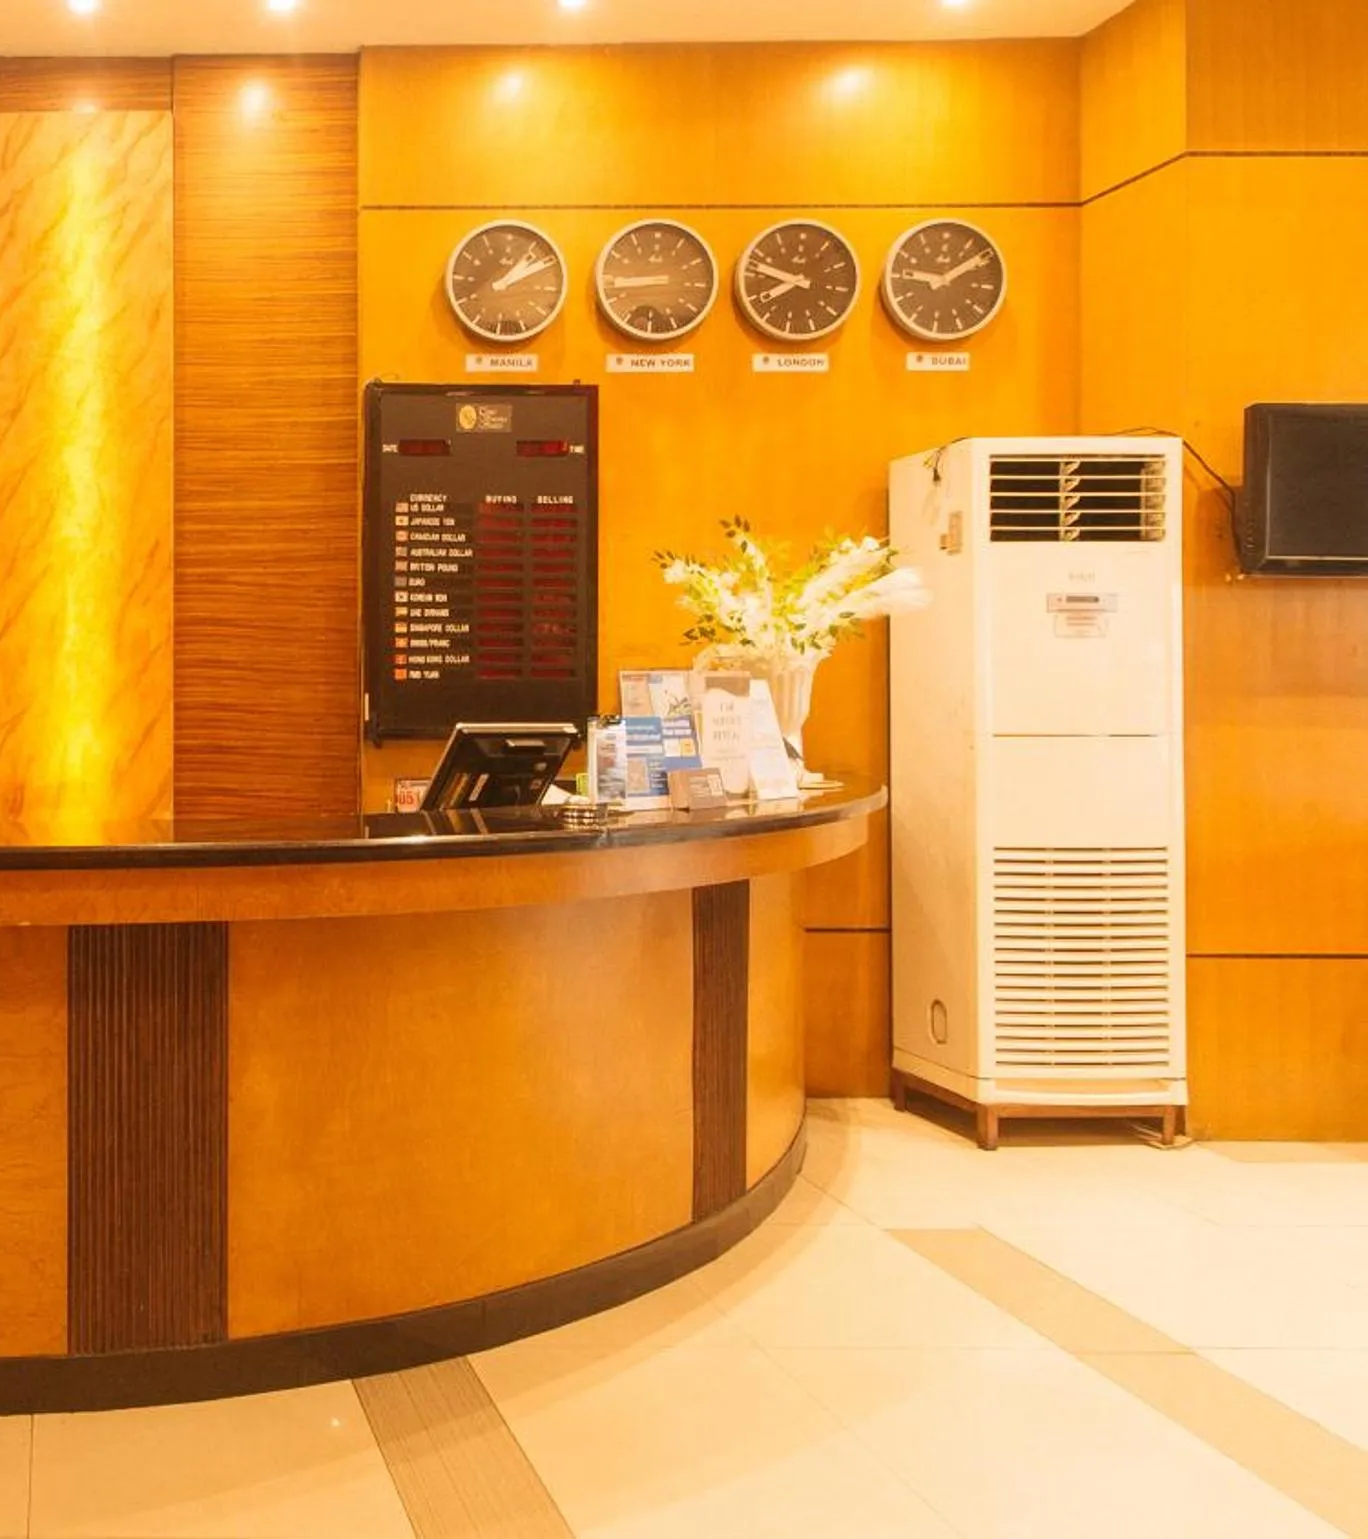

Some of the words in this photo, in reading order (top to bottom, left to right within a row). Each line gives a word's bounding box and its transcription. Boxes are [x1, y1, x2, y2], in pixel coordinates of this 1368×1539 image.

[490, 358, 532, 367] MANILA
[631, 358, 656, 368] NEW
[660, 358, 690, 367] YORK
[777, 358, 825, 367] LONDON
[931, 356, 967, 366] DUBAI
[410, 493, 447, 502] CURRENCY
[485, 495, 517, 504] BUYING
[537, 495, 574, 504] SELLING
[421, 502, 444, 512] DOLLAR
[441, 532, 466, 542] DOLLAR
[410, 548, 447, 557] AUSTRALIAN
[448, 548, 473, 557] DOLLAR
[437, 562, 458, 572] POUND
[445, 623, 470, 633] DOLLAR
[445, 655, 470, 664] DOLLAR
